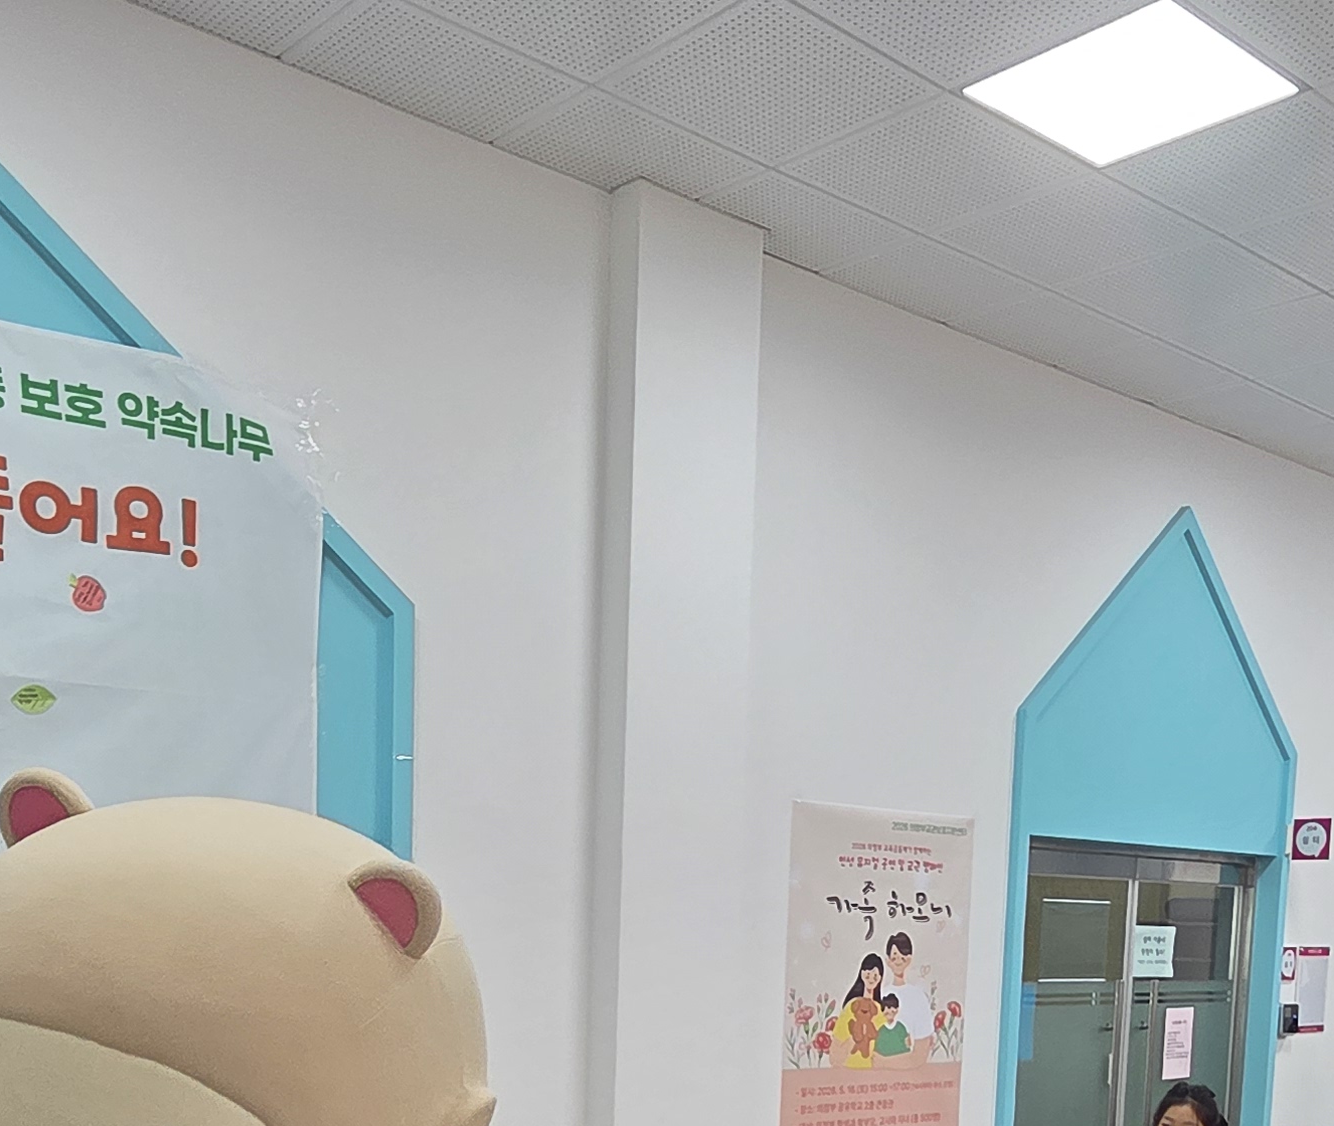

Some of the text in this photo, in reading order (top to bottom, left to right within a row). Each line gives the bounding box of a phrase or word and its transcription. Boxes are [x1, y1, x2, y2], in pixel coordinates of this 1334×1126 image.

[20, 372, 107, 429] 보호
[117, 391, 274, 462] 약속나무
[826, 880, 952, 941] 가족 하모니
